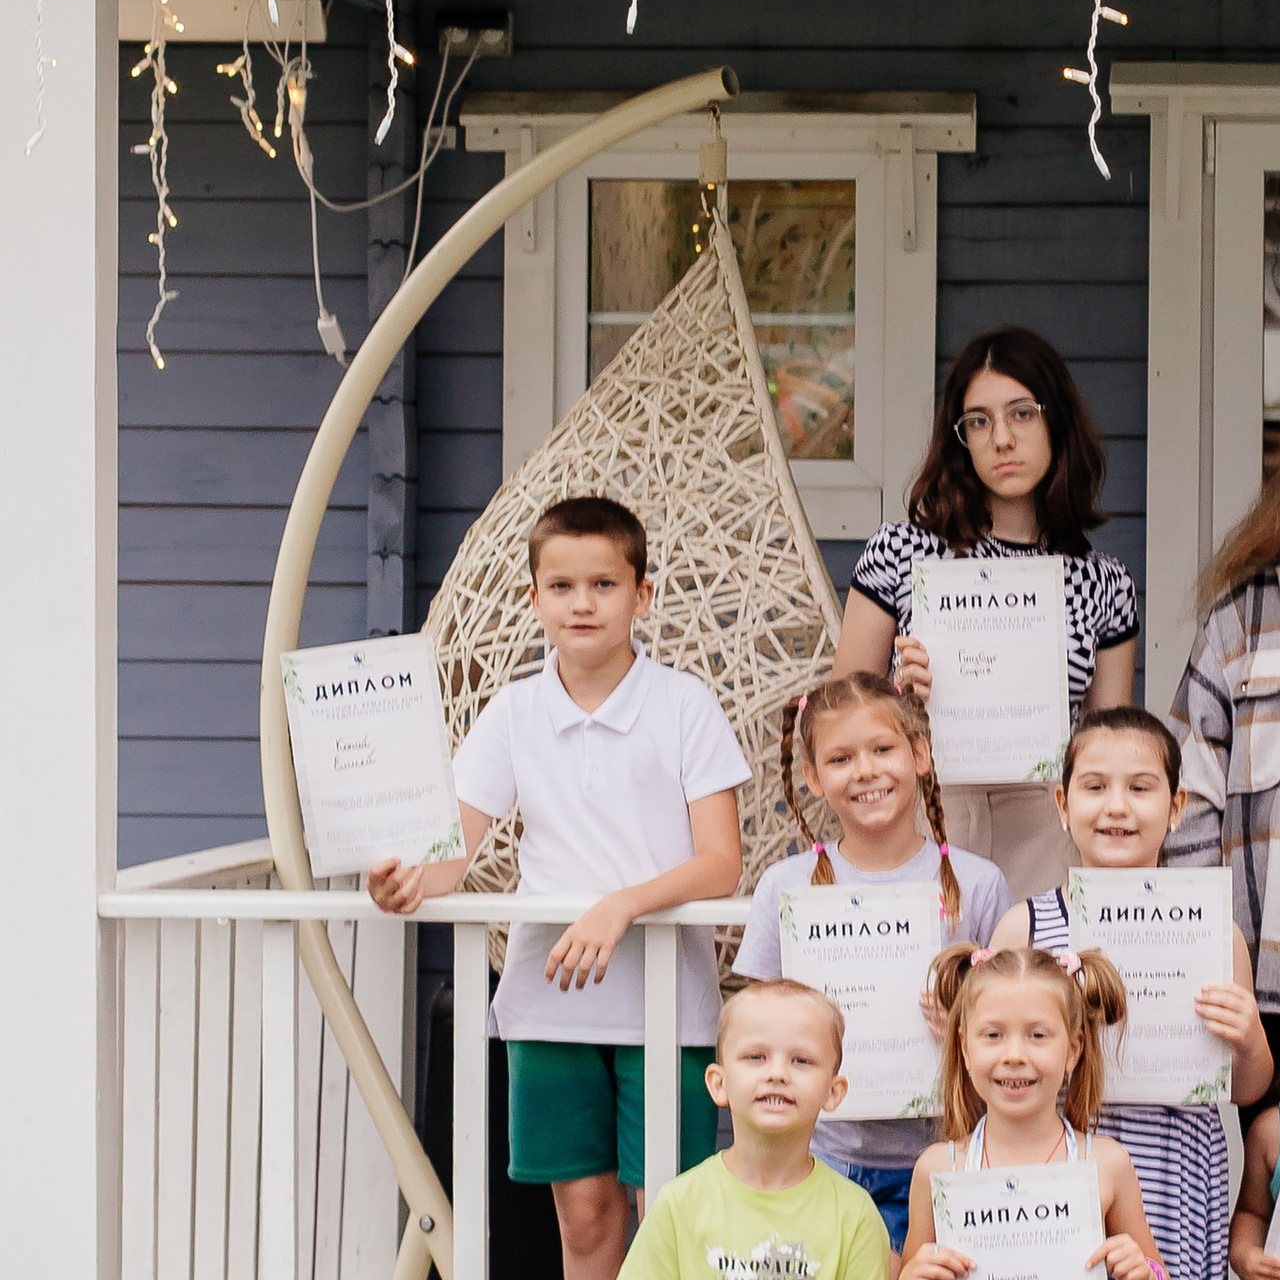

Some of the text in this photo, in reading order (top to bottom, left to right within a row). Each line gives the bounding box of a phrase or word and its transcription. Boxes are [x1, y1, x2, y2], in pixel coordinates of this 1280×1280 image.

[939, 592, 1037, 612] ДИПЛОМ
[315, 672, 412, 702] ДИПЛОМ
[1098, 906, 1202, 924] ДИПЛОМ
[808, 920, 910, 940] ДИПЛОМ
[963, 1202, 1069, 1228] ДИПЛОМ
[718, 1256, 808, 1278] DINOSAUR
